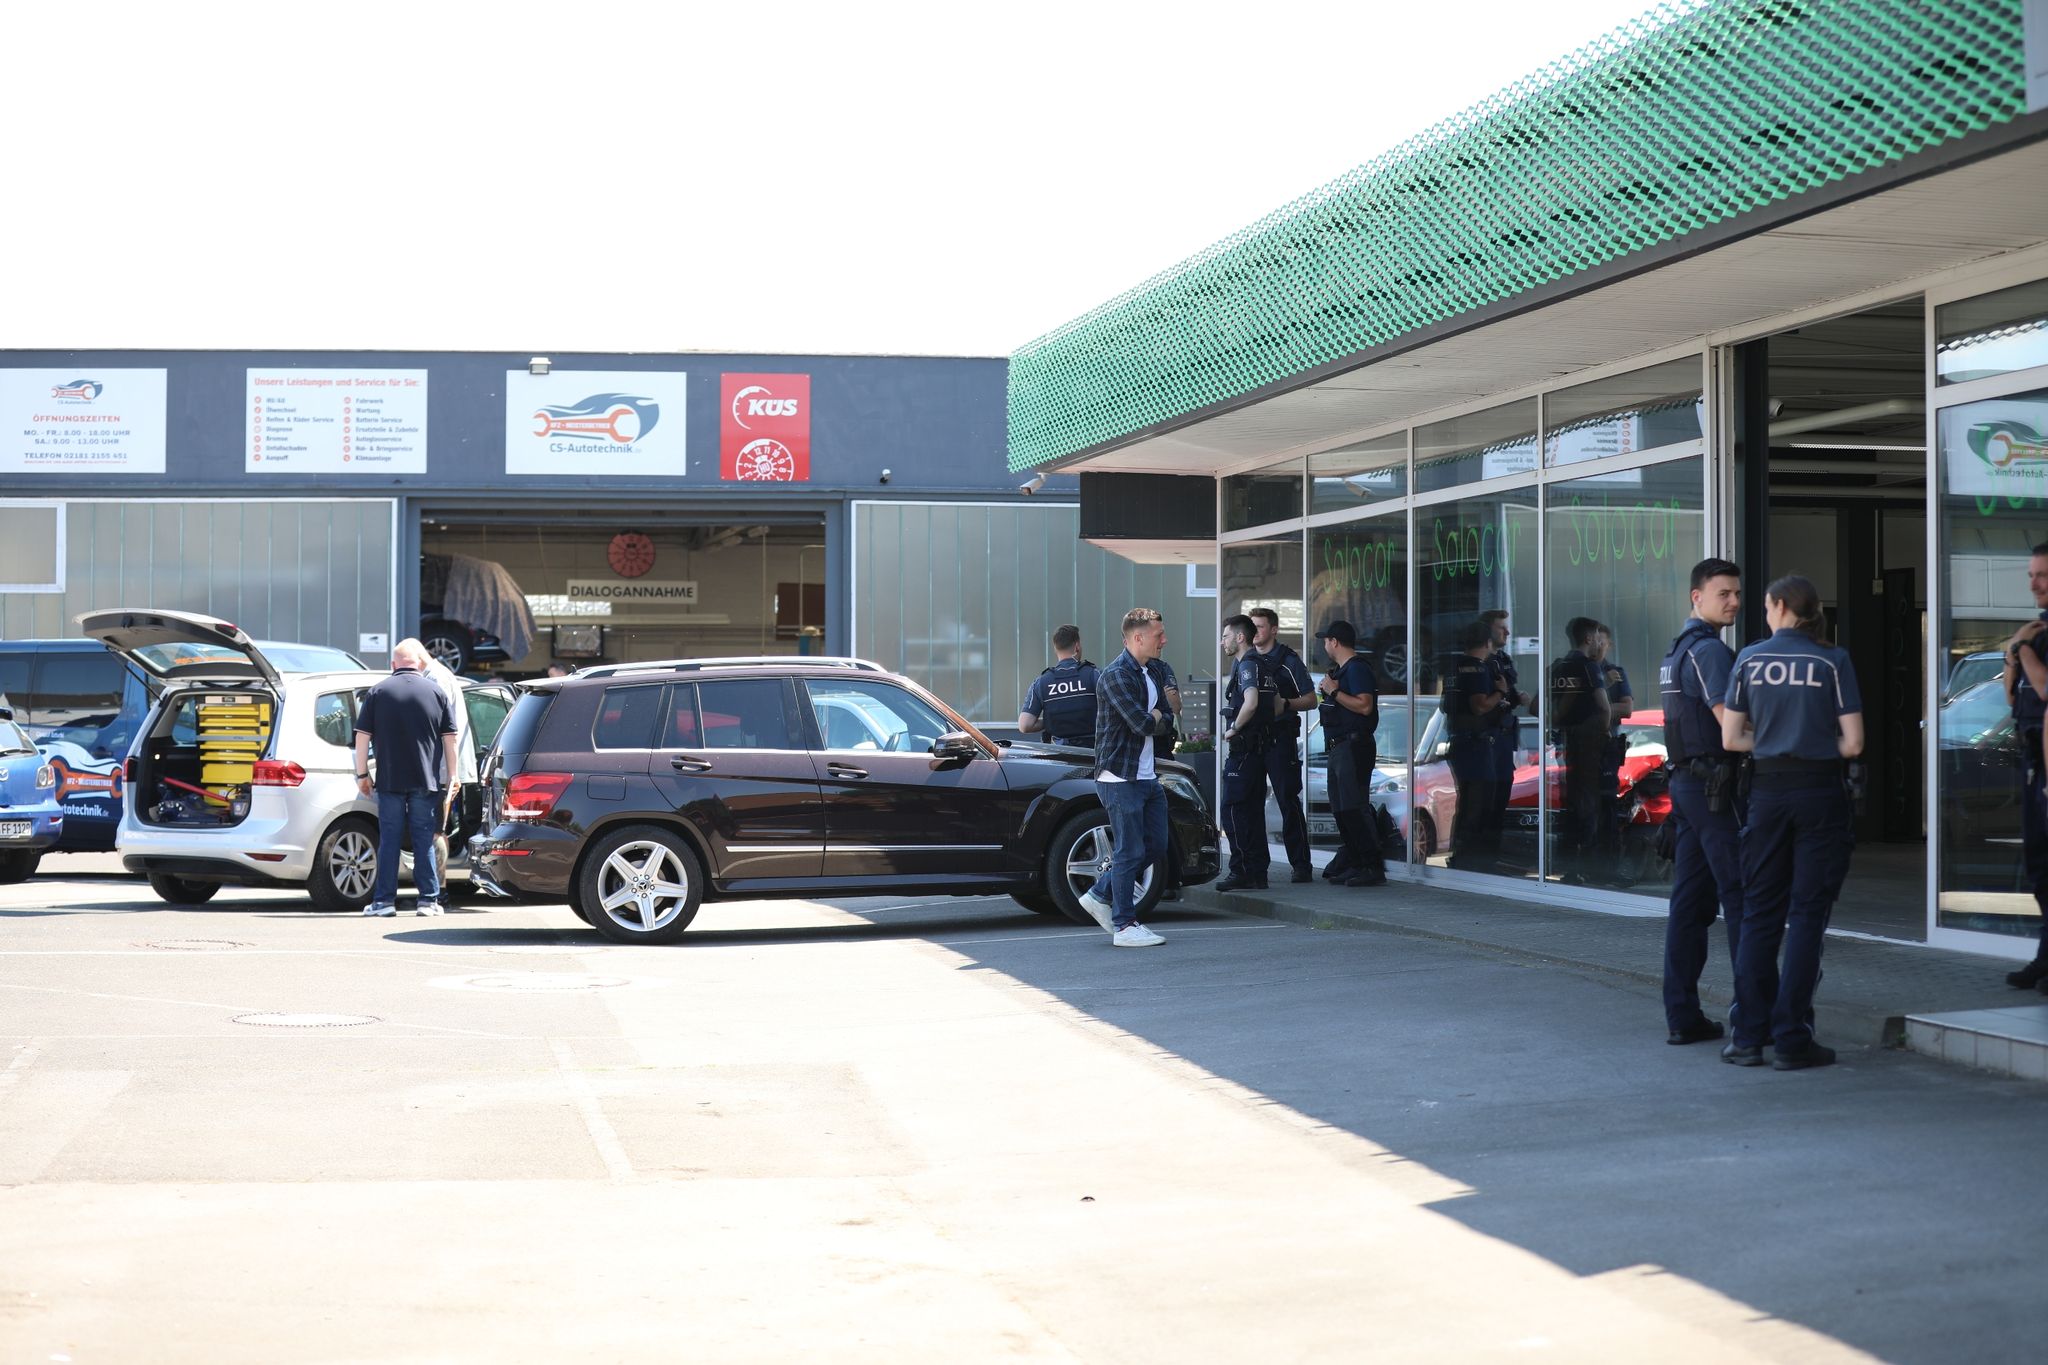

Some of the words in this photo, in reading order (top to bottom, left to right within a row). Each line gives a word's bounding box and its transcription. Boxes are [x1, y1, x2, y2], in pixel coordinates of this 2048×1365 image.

[254, 378, 284, 386] Unsere
[287, 378, 333, 388] Leistungen
[32, 414, 120, 422] ÖFFNUNGSZEITEN
[1324, 536, 1394, 594] Solocar
[571, 586, 693, 598] DIALOGANNAHME
[1748, 661, 1822, 687] ZOLL
[1048, 680, 1086, 695] ZOLL
[2, 823, 11, 834] FF
